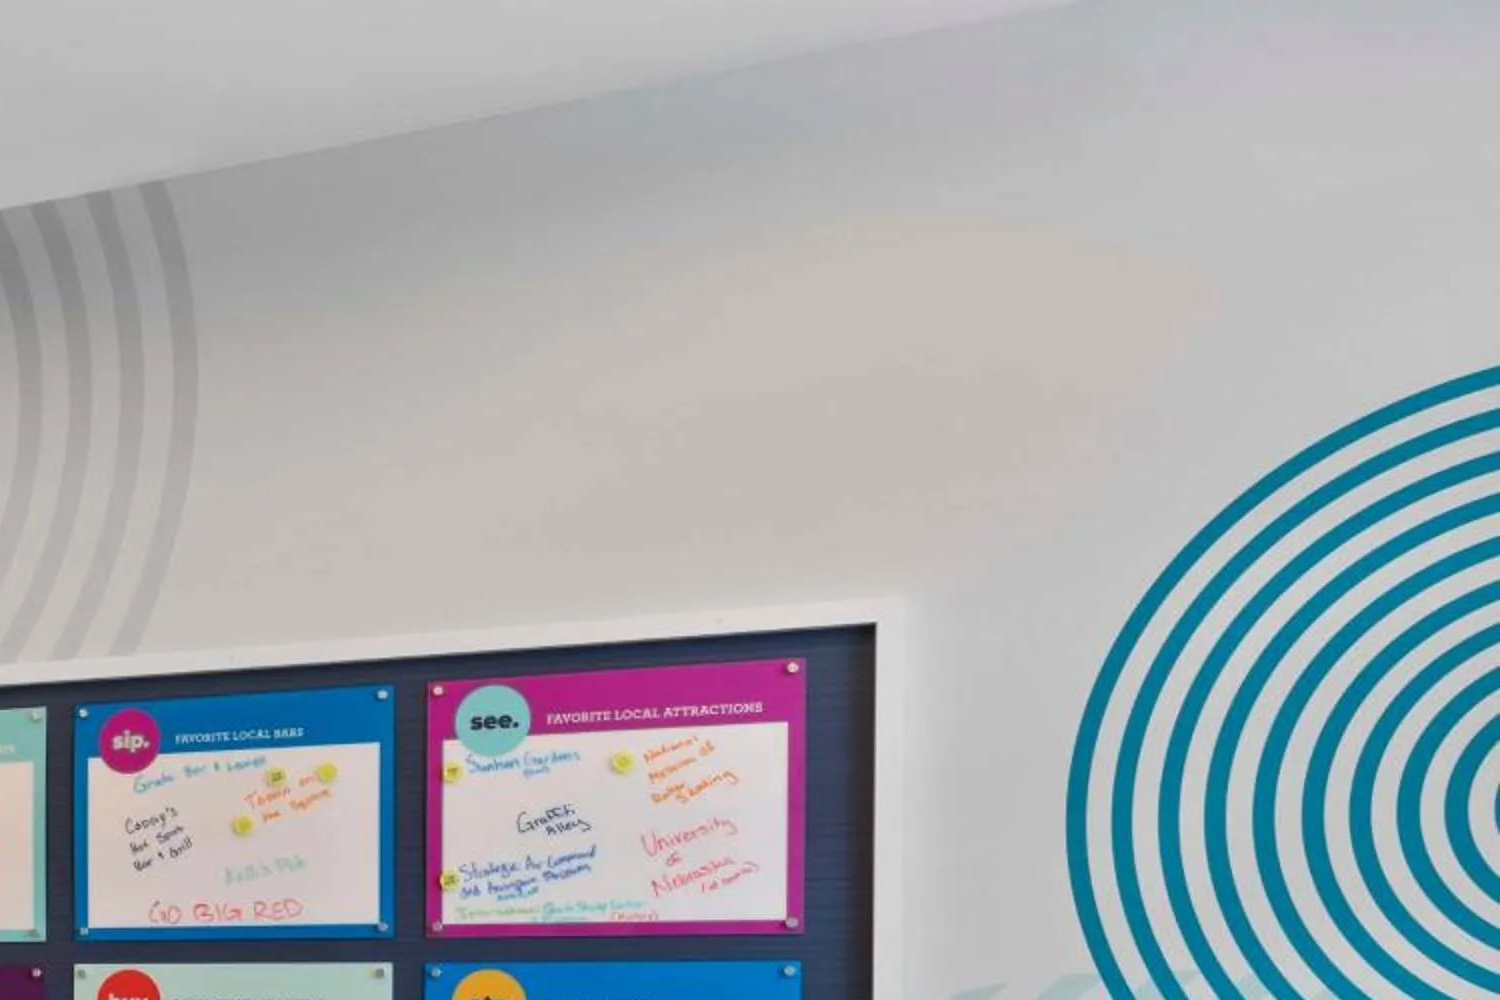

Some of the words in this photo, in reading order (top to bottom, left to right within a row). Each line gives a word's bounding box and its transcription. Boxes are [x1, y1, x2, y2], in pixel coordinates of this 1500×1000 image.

[469, 713, 520, 731] see.
[546, 711, 612, 726] FAVORITE
[613, 707, 661, 722] LOCAL
[663, 701, 764, 719] ATTRACTIONS
[111, 729, 150, 753] sip.
[174, 732, 231, 745] FAVORITE
[232, 729, 271, 742] LOCAL
[273, 727, 304, 739] BARS
[148, 899, 182, 925] GO
[253, 898, 304, 922] RED
